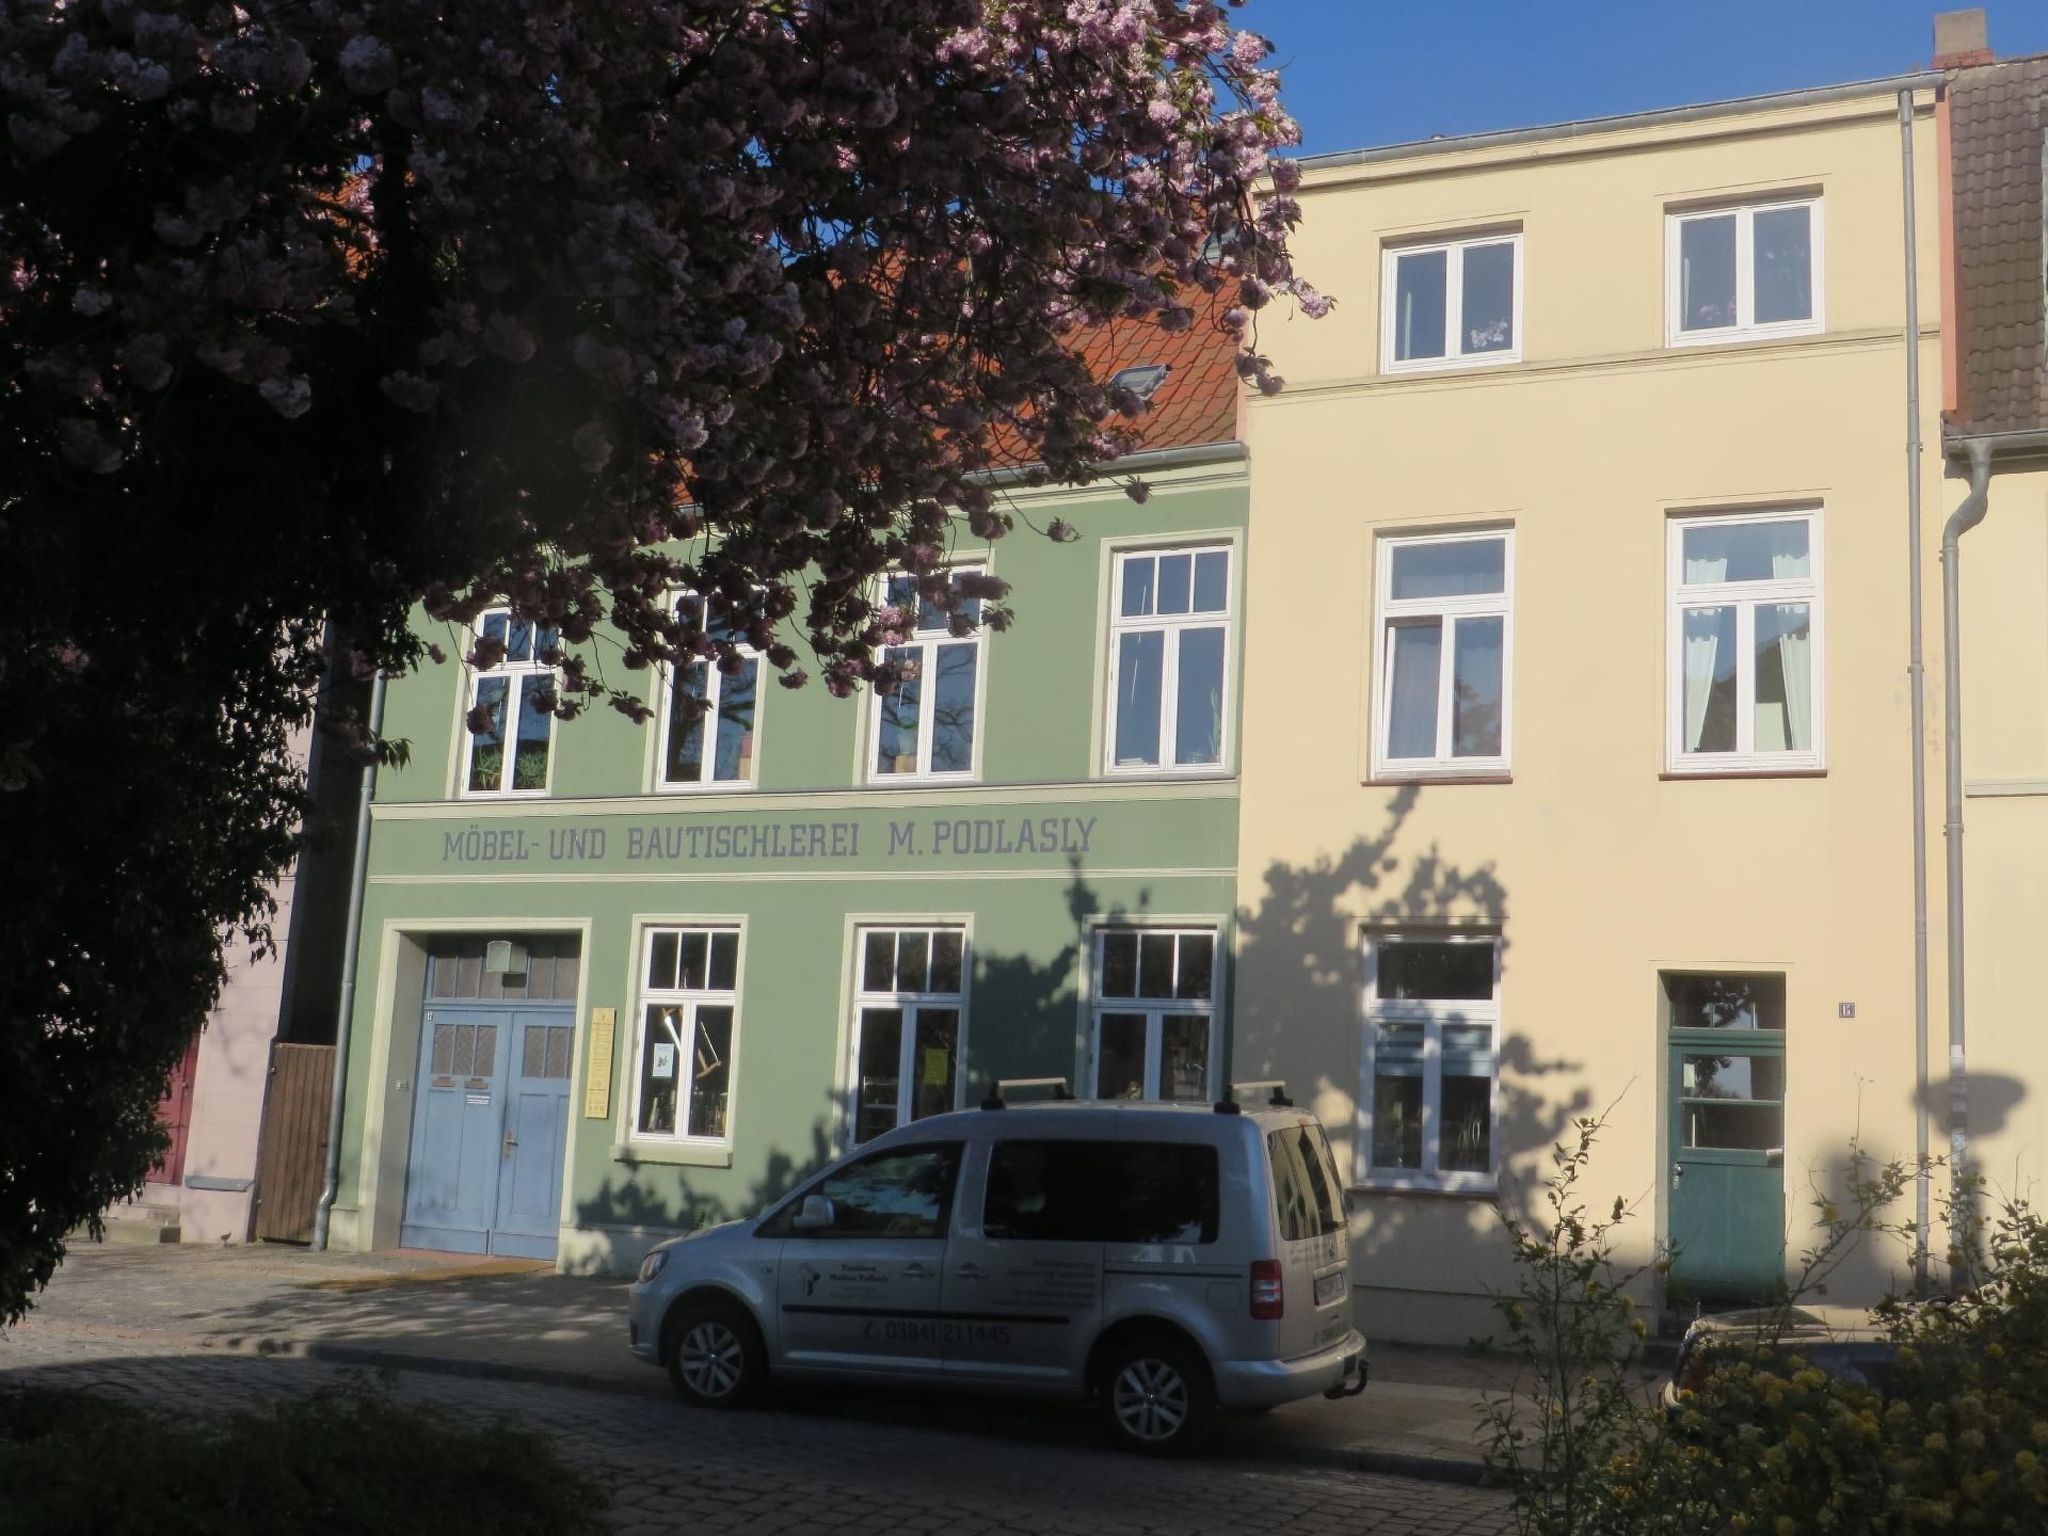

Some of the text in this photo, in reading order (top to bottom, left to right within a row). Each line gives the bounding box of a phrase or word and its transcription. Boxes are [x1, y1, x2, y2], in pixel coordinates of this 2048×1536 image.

[442, 816, 1098, 861] MÖBEL- UND BAUTISCHLEREI M. PODLASLY
[886, 1321, 936, 1341] 03841
